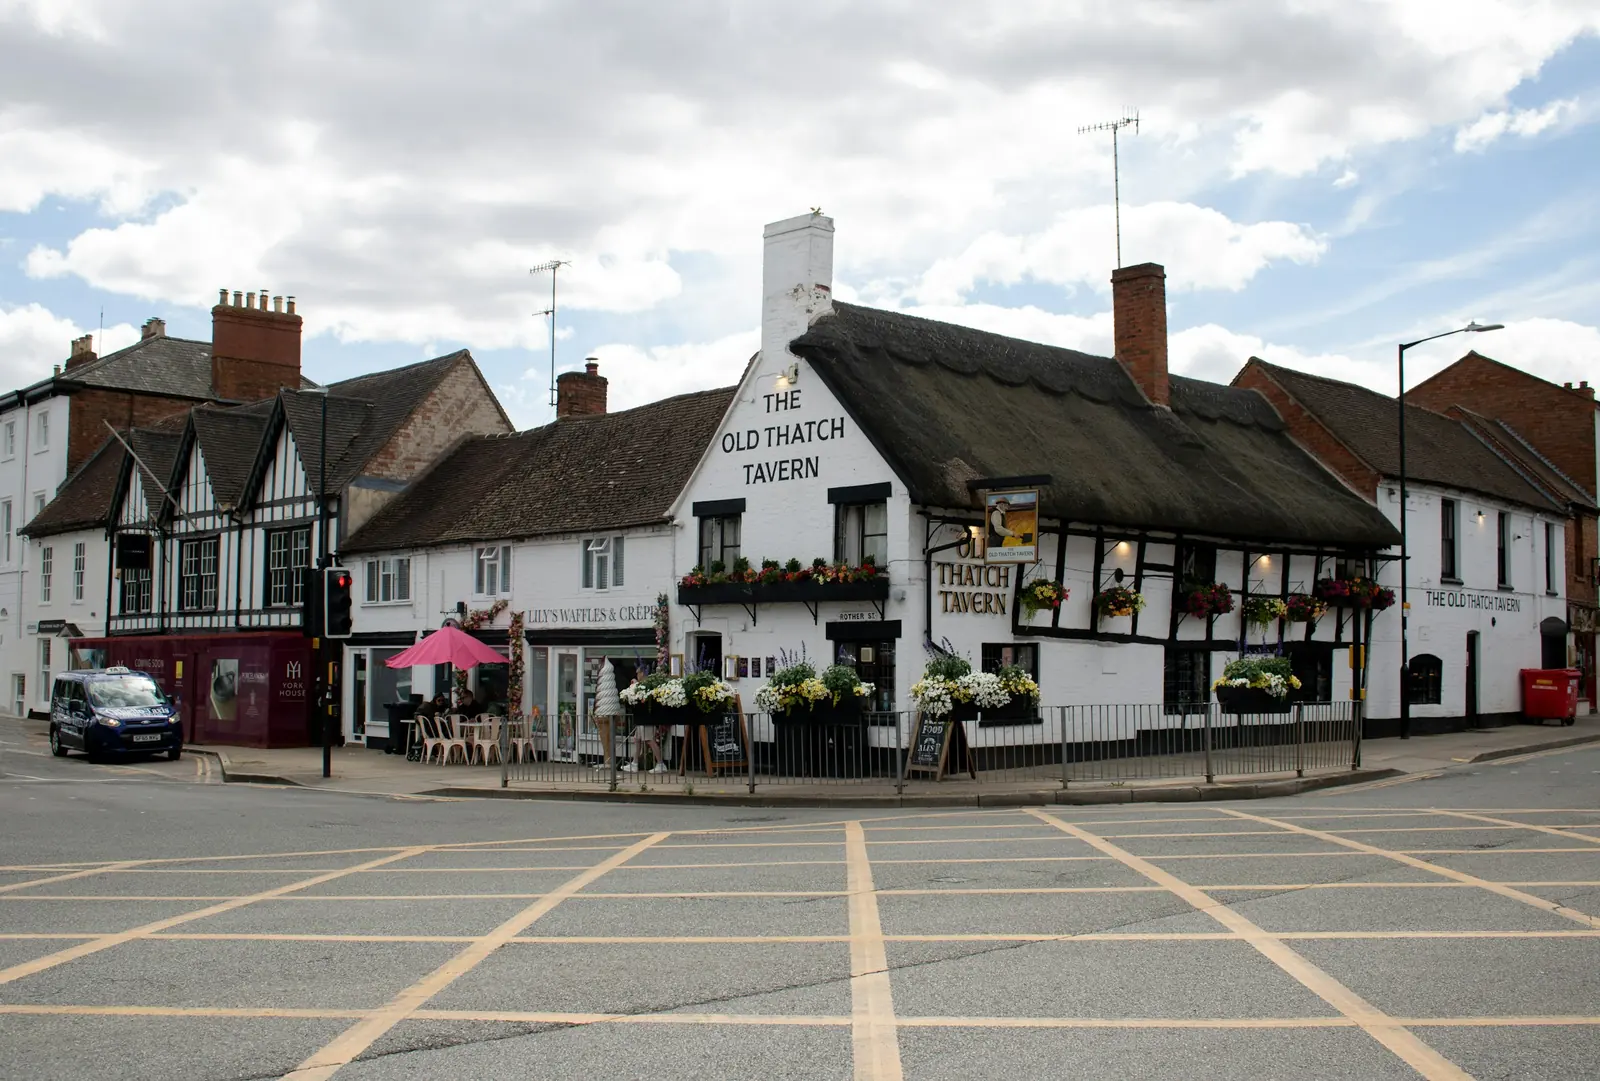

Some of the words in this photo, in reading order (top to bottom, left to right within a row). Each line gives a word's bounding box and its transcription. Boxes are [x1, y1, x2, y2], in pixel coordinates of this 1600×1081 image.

[763, 389, 802, 413] THE
[722, 430, 759, 453] OLD
[764, 417, 844, 447] THATCH
[743, 456, 819, 485] TAVERN
[937, 562, 1009, 588] THATCH
[938, 590, 1007, 615] TAVERN
[1426, 591, 1446, 607] THE
[1447, 592, 1466, 608] OLD
[1466, 594, 1494, 610] THATCH
[1494, 596, 1520, 612] TAVERN
[528, 608, 558, 623] LILY'S
[560, 607, 607, 622] WAFFLES
[608, 608, 617, 621] &
[619, 603, 660, 621] CRÊPE
[840, 612, 865, 621] ROTHER
[134, 658, 151, 668] COMING
[152, 658, 165, 668] SOON
[279, 689, 306, 697] HOUSE
[921, 725, 943, 734] FOOD
